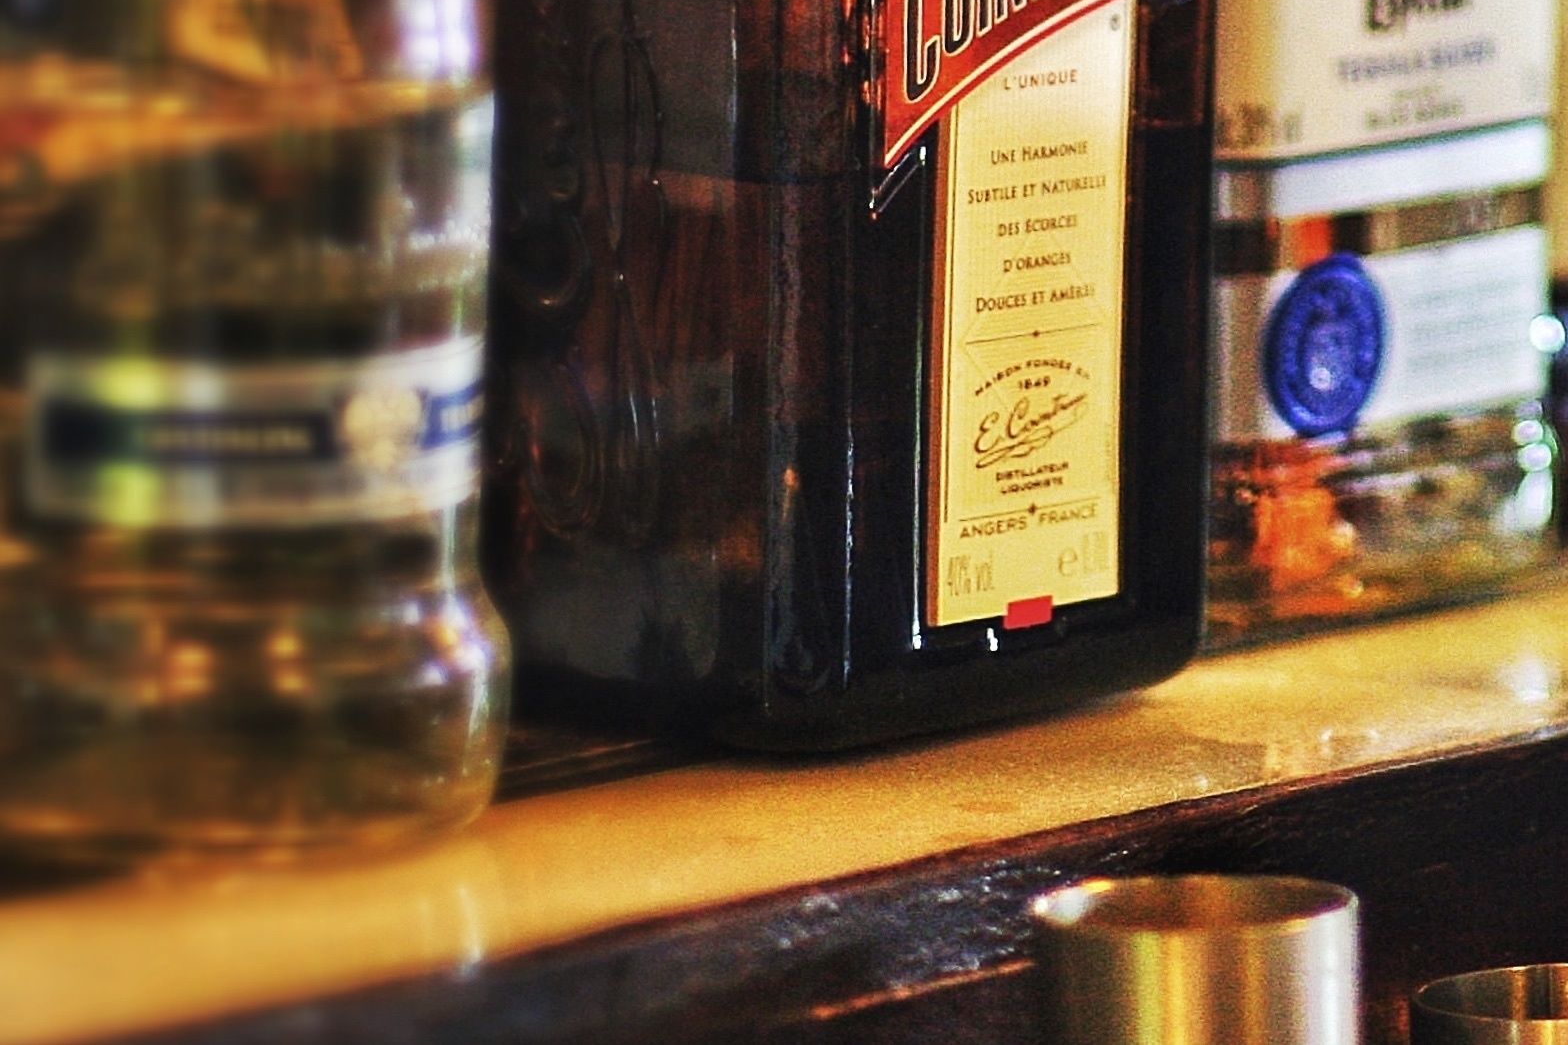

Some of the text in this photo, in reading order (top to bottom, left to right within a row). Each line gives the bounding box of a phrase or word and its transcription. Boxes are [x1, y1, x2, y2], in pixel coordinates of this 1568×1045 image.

[1003, 68, 1078, 91] L'UNIQUE
[1022, 181, 1036, 197] ET
[997, 222, 1020, 236] DES
[1032, 290, 1045, 305] ET
[959, 504, 1098, 540] ANGERS FRANCE
